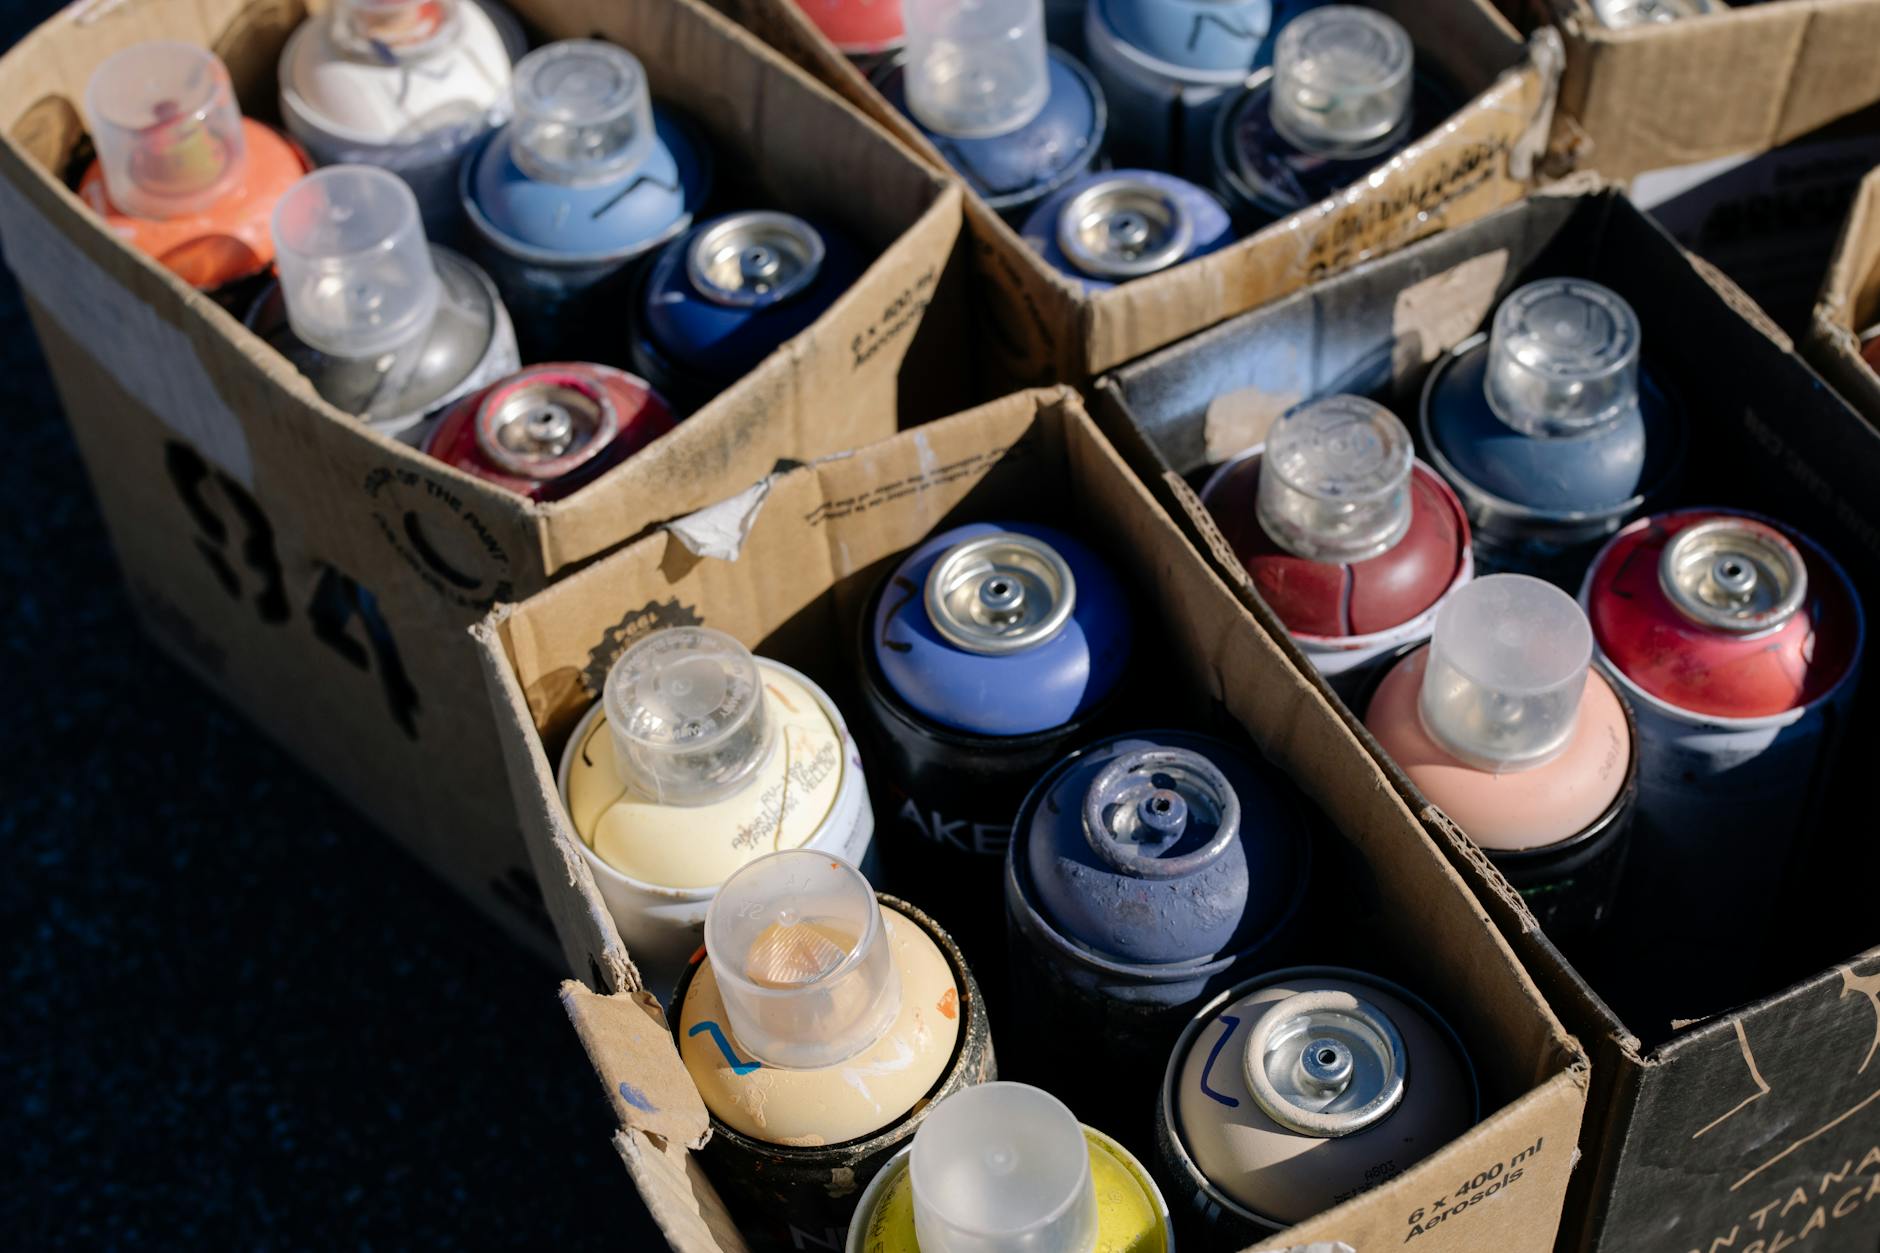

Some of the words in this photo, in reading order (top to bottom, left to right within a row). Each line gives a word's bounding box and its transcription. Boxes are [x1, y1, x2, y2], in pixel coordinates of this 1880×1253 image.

[424, 477, 463, 513] THE
[463, 511, 509, 563] PAINT
[1403, 1166, 1525, 1244] Aerosols
[1407, 1207, 1425, 1226] 6
[1431, 1195, 1448, 1217] x
[1455, 1161, 1505, 1199] 400
[1510, 1136, 1545, 1169] ml
[1688, 1145, 1880, 1253] NTANA
